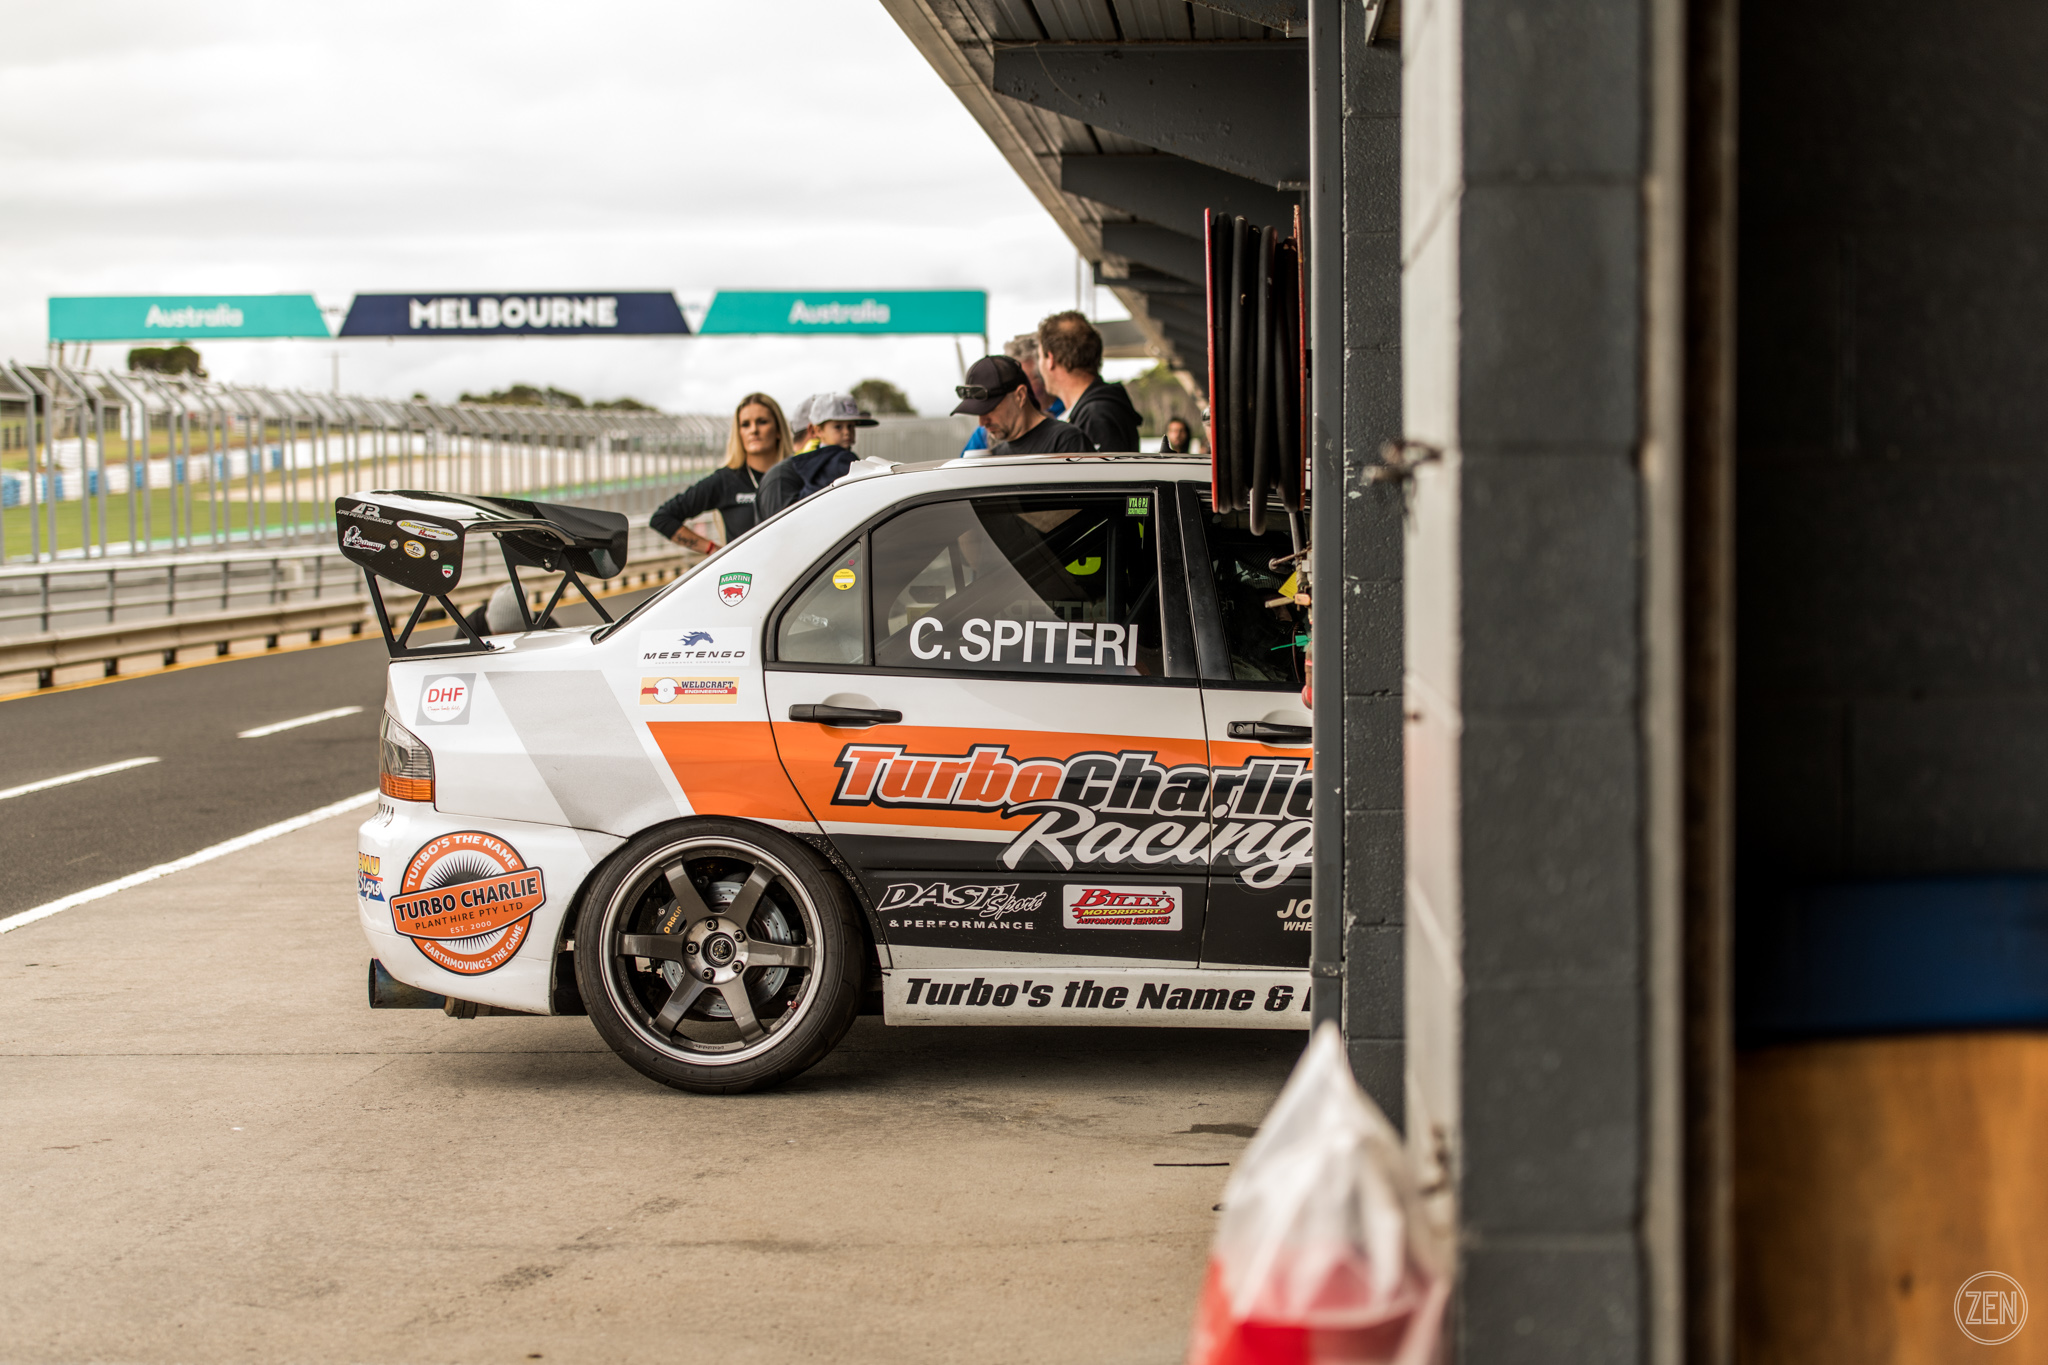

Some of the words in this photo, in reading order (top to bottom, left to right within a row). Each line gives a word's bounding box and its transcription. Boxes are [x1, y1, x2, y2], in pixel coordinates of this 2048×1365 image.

[145, 303, 243, 328] Australia
[409, 296, 618, 328] MELBOURNE
[789, 299, 889, 324] Australia
[349, 511, 394, 525] PERFORMANCE
[721, 575, 750, 583] MARTINI
[910, 617, 951, 660] C.
[960, 618, 1139, 666] SPITERI
[644, 651, 745, 659] MESTENGO
[428, 687, 464, 702] DHF
[406, 838, 451, 888] TURBO'S
[453, 835, 481, 845] THE
[482, 837, 518, 869] NAME
[358, 869, 381, 901] Signs
[395, 893, 456, 921] TURBO
[461, 876, 538, 908] CHARLIE
[878, 882, 1019, 911] DASH
[980, 891, 1047, 919] Sport
[1070, 889, 1175, 909] BILLY'S
[415, 918, 447, 930] PLANT
[449, 912, 475, 923] HIRE
[478, 907, 498, 918] PTY
[504, 901, 523, 913] LTD
[450, 925, 468, 934] EST.
[469, 920, 492, 931] 2000
[889, 919, 899, 928] &
[903, 920, 1035, 930] PERFORMANCE
[1077, 917, 1132, 925] AUTOMOTIVE
[1133, 916, 1170, 925] SERVICES
[1283, 921, 1312, 932] WHE
[423, 941, 493, 971] EARTHMOVING'S
[489, 948, 510, 964] THE
[504, 924, 524, 951] GAME
[906, 977, 1054, 1008] Turbo's
[1062, 980, 1129, 1009] the
[1137, 982, 1255, 1011] Name
[1263, 984, 1294, 1012] &
